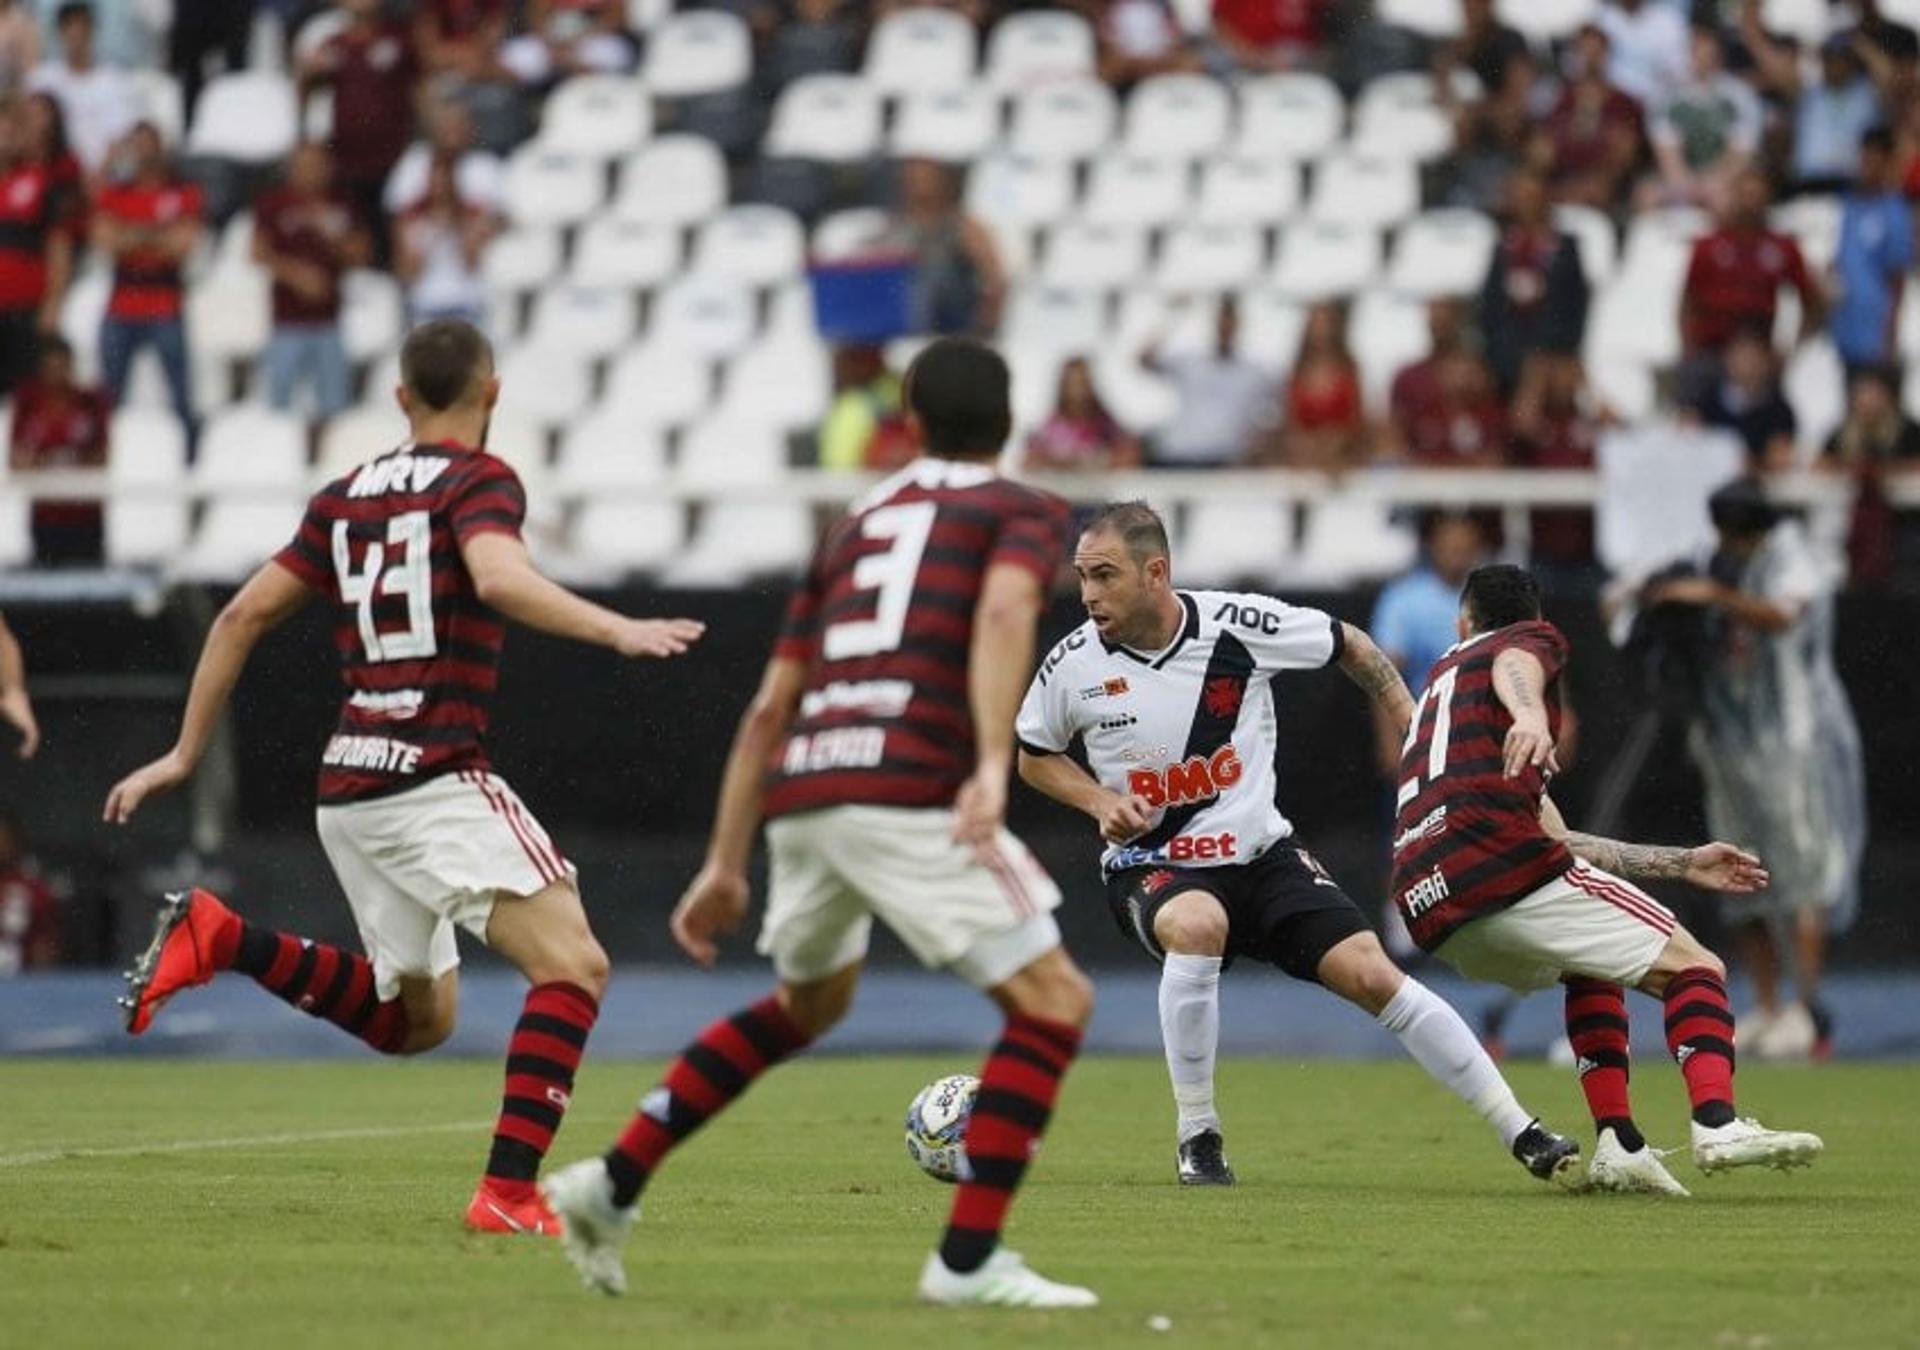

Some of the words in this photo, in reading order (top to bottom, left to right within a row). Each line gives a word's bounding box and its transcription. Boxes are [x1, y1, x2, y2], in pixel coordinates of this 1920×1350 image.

[347, 455, 451, 498] MRV
[331, 510, 438, 663] 43
[822, 500, 937, 662] 3
[1126, 744, 1243, 808] BMG
[1404, 864, 1450, 918] PARÁ
